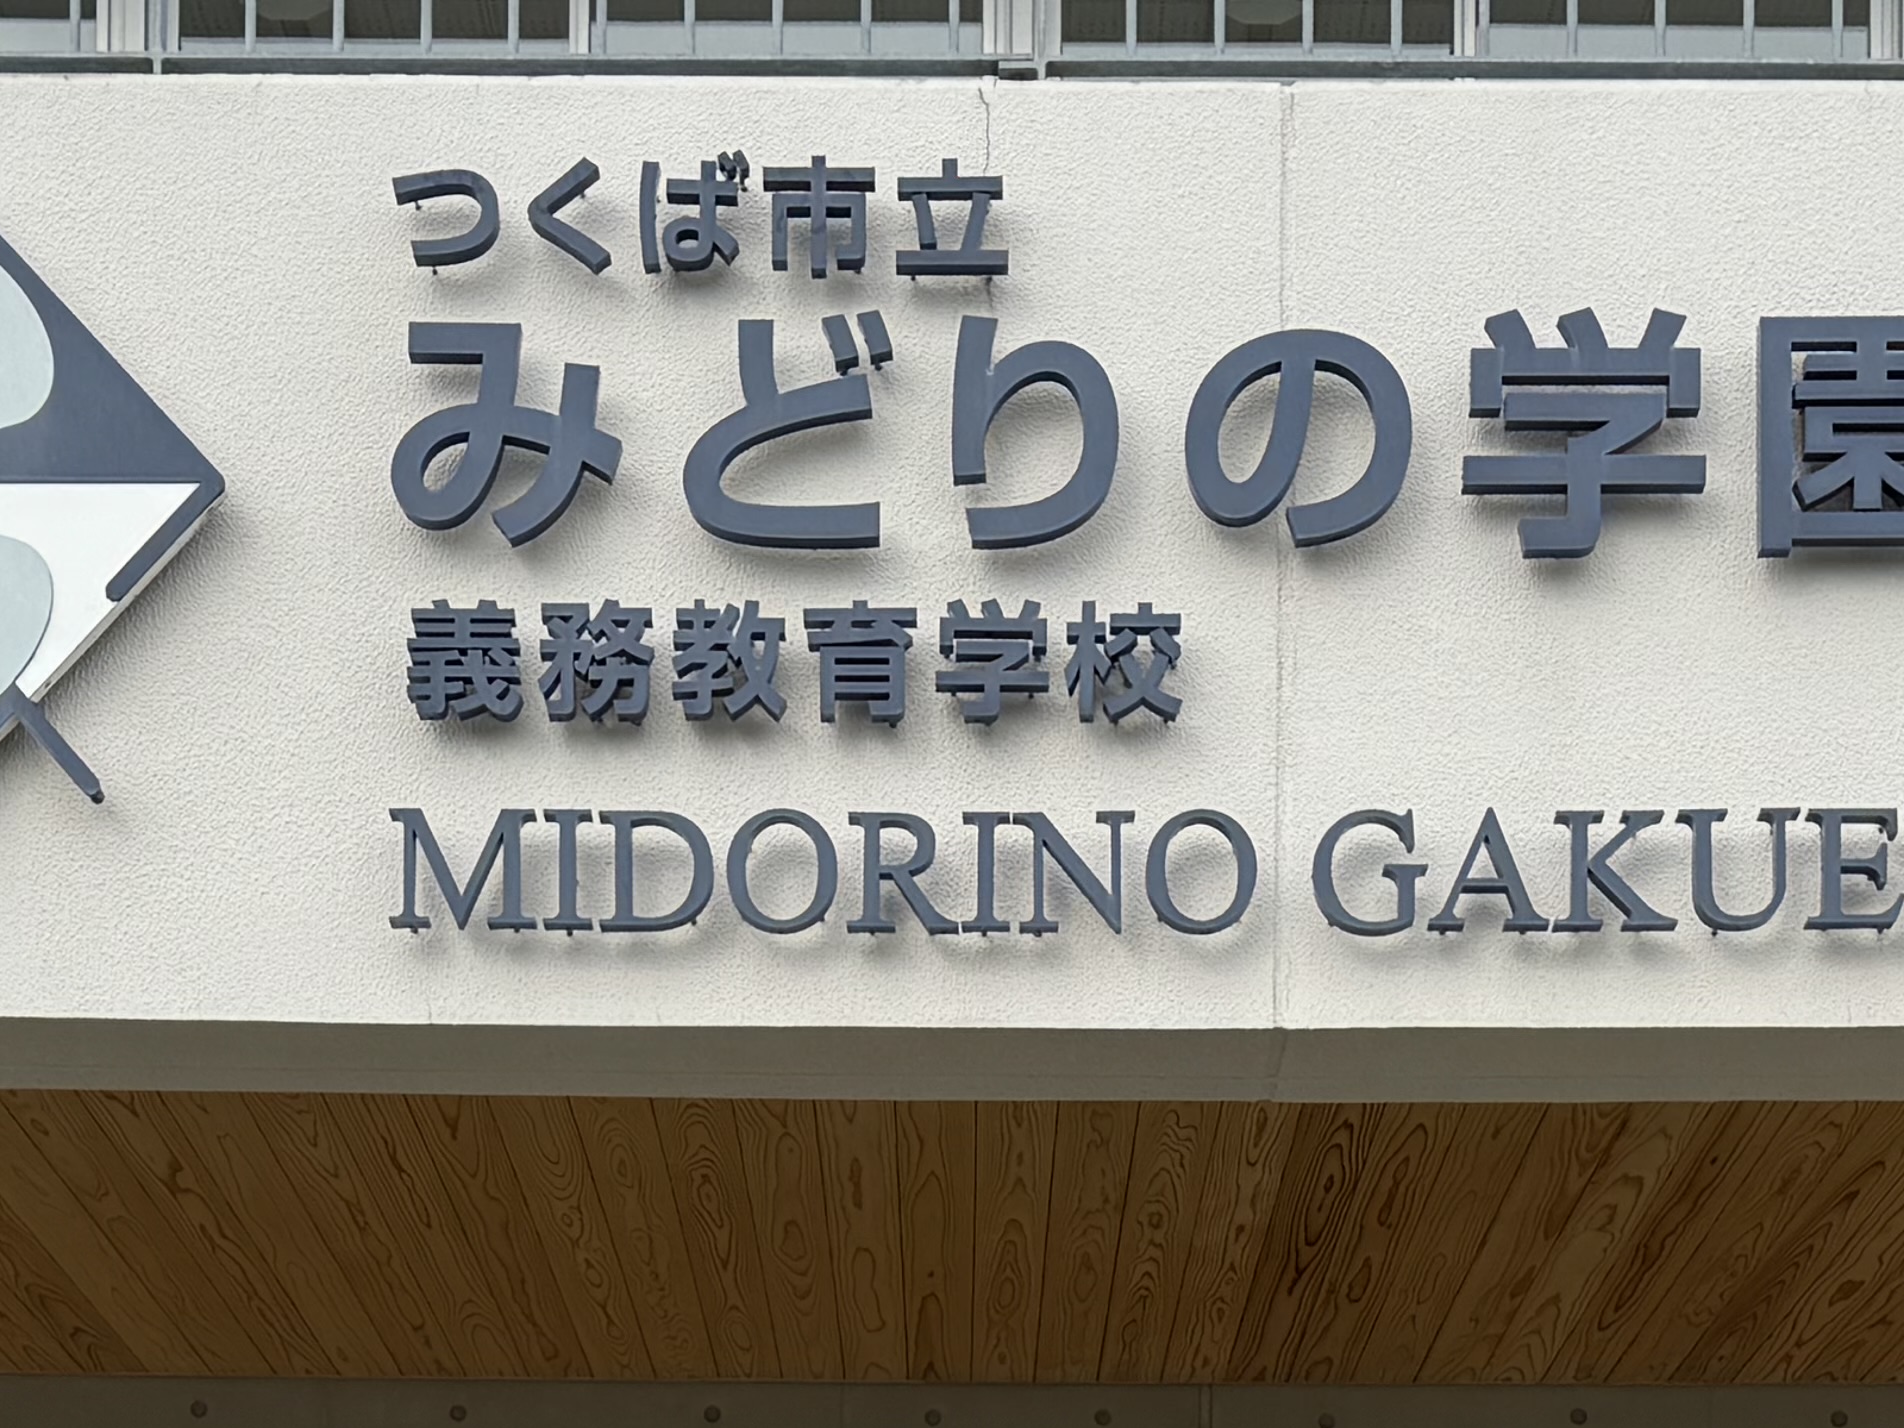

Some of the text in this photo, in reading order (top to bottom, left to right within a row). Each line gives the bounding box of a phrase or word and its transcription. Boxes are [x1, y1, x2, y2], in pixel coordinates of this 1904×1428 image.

[392, 150, 1009, 280] つくば市立
[406, 598, 1184, 727] 義務教育学校
[389, 808, 1258, 938] MIDORINO
